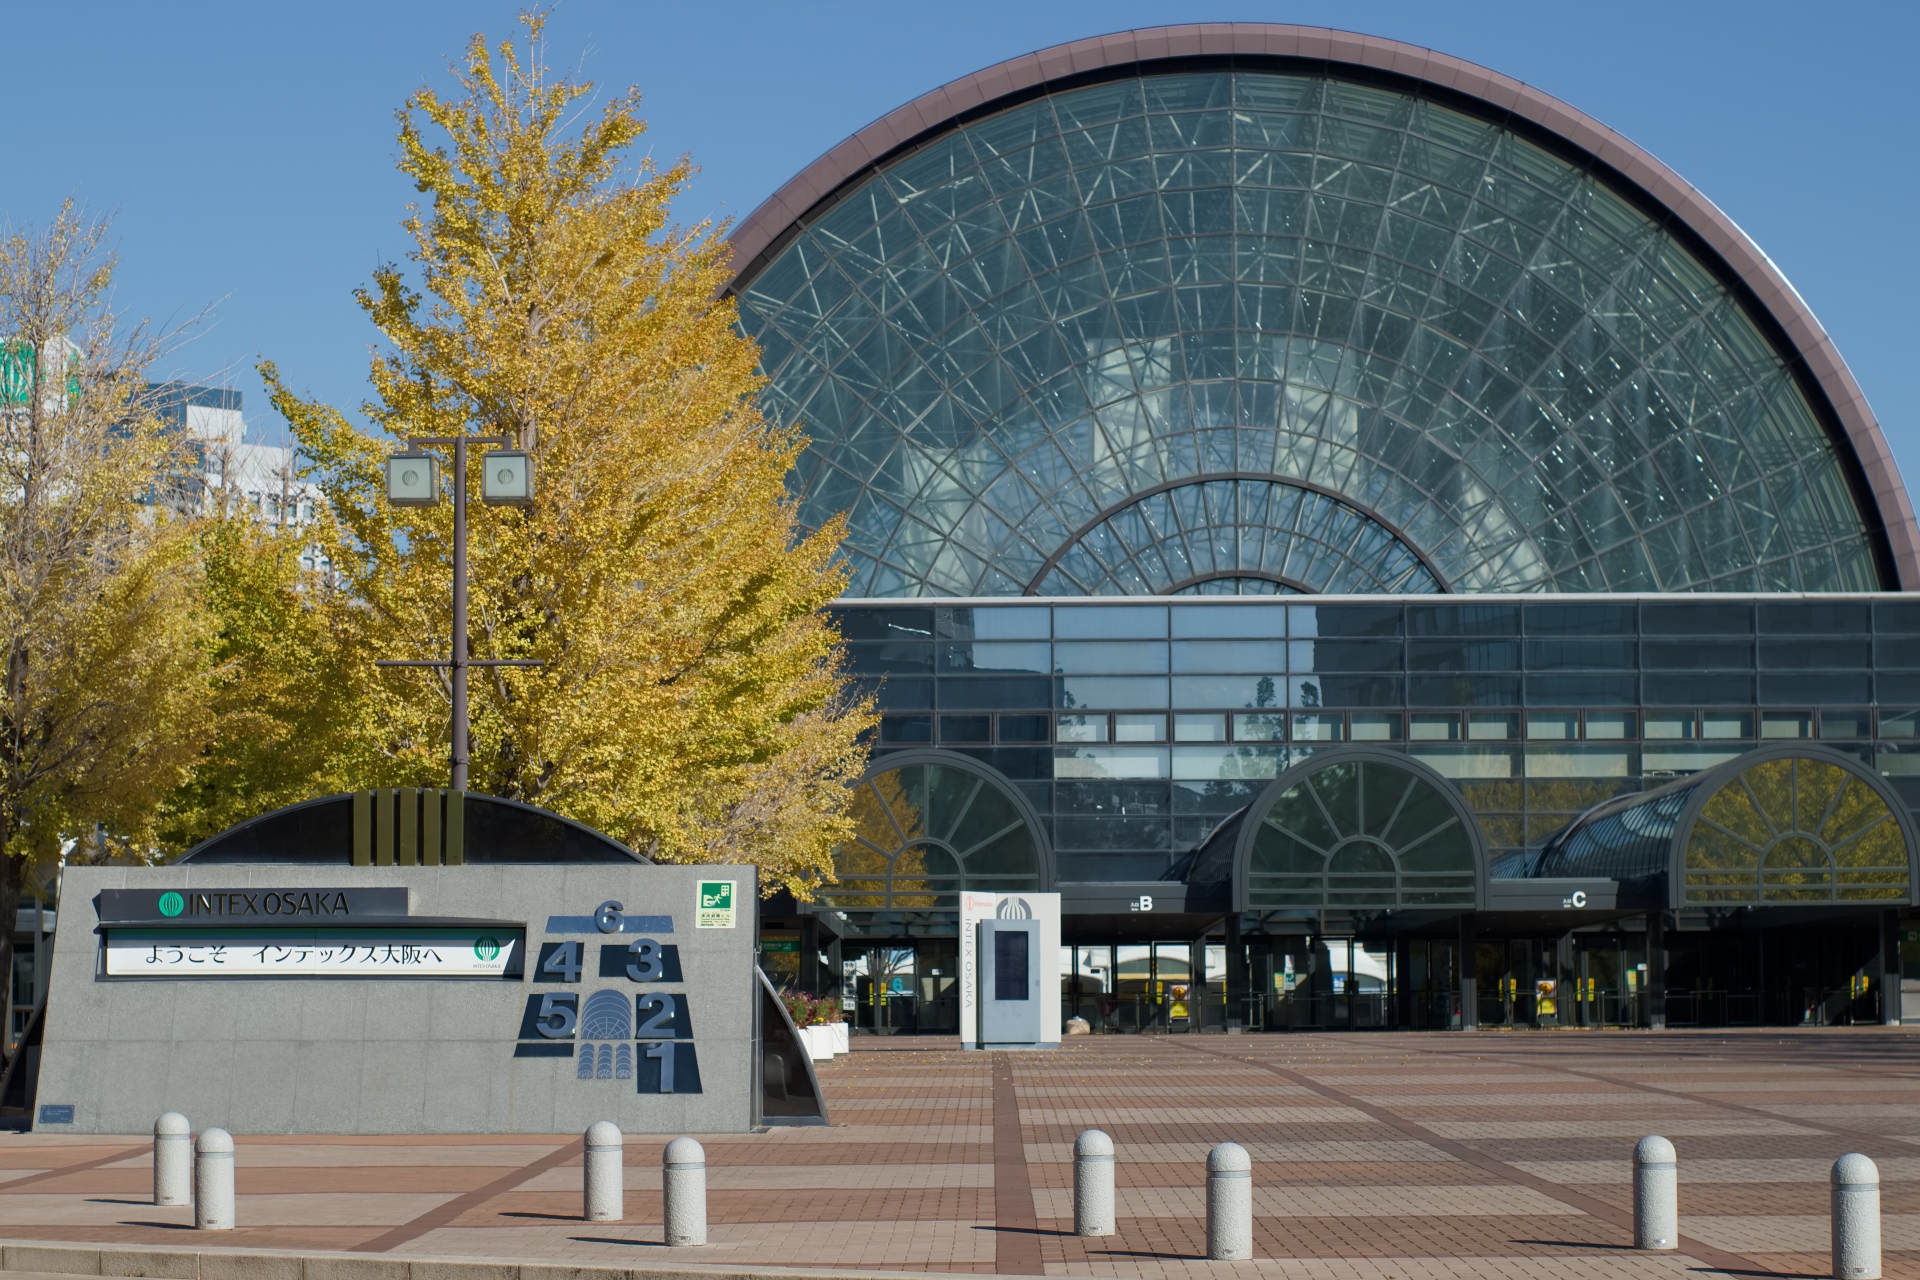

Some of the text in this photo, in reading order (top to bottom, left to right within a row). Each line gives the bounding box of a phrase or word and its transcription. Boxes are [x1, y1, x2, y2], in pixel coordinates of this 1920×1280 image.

[189, 892, 350, 916] INTEX OSAKA
[596, 900, 624, 934] 6
[1139, 895, 1153, 911] B
[1572, 890, 1587, 908] C
[145, 944, 443, 965] ようこそ インテックス大阪へ
[544, 940, 582, 983] 4
[626, 938, 664, 983] 3
[892, 977, 903, 991] 6
[965, 961, 973, 1008] OSAKA
[536, 992, 577, 1039] 5
[635, 992, 676, 1039] 2
[646, 1041, 675, 1093] 1
